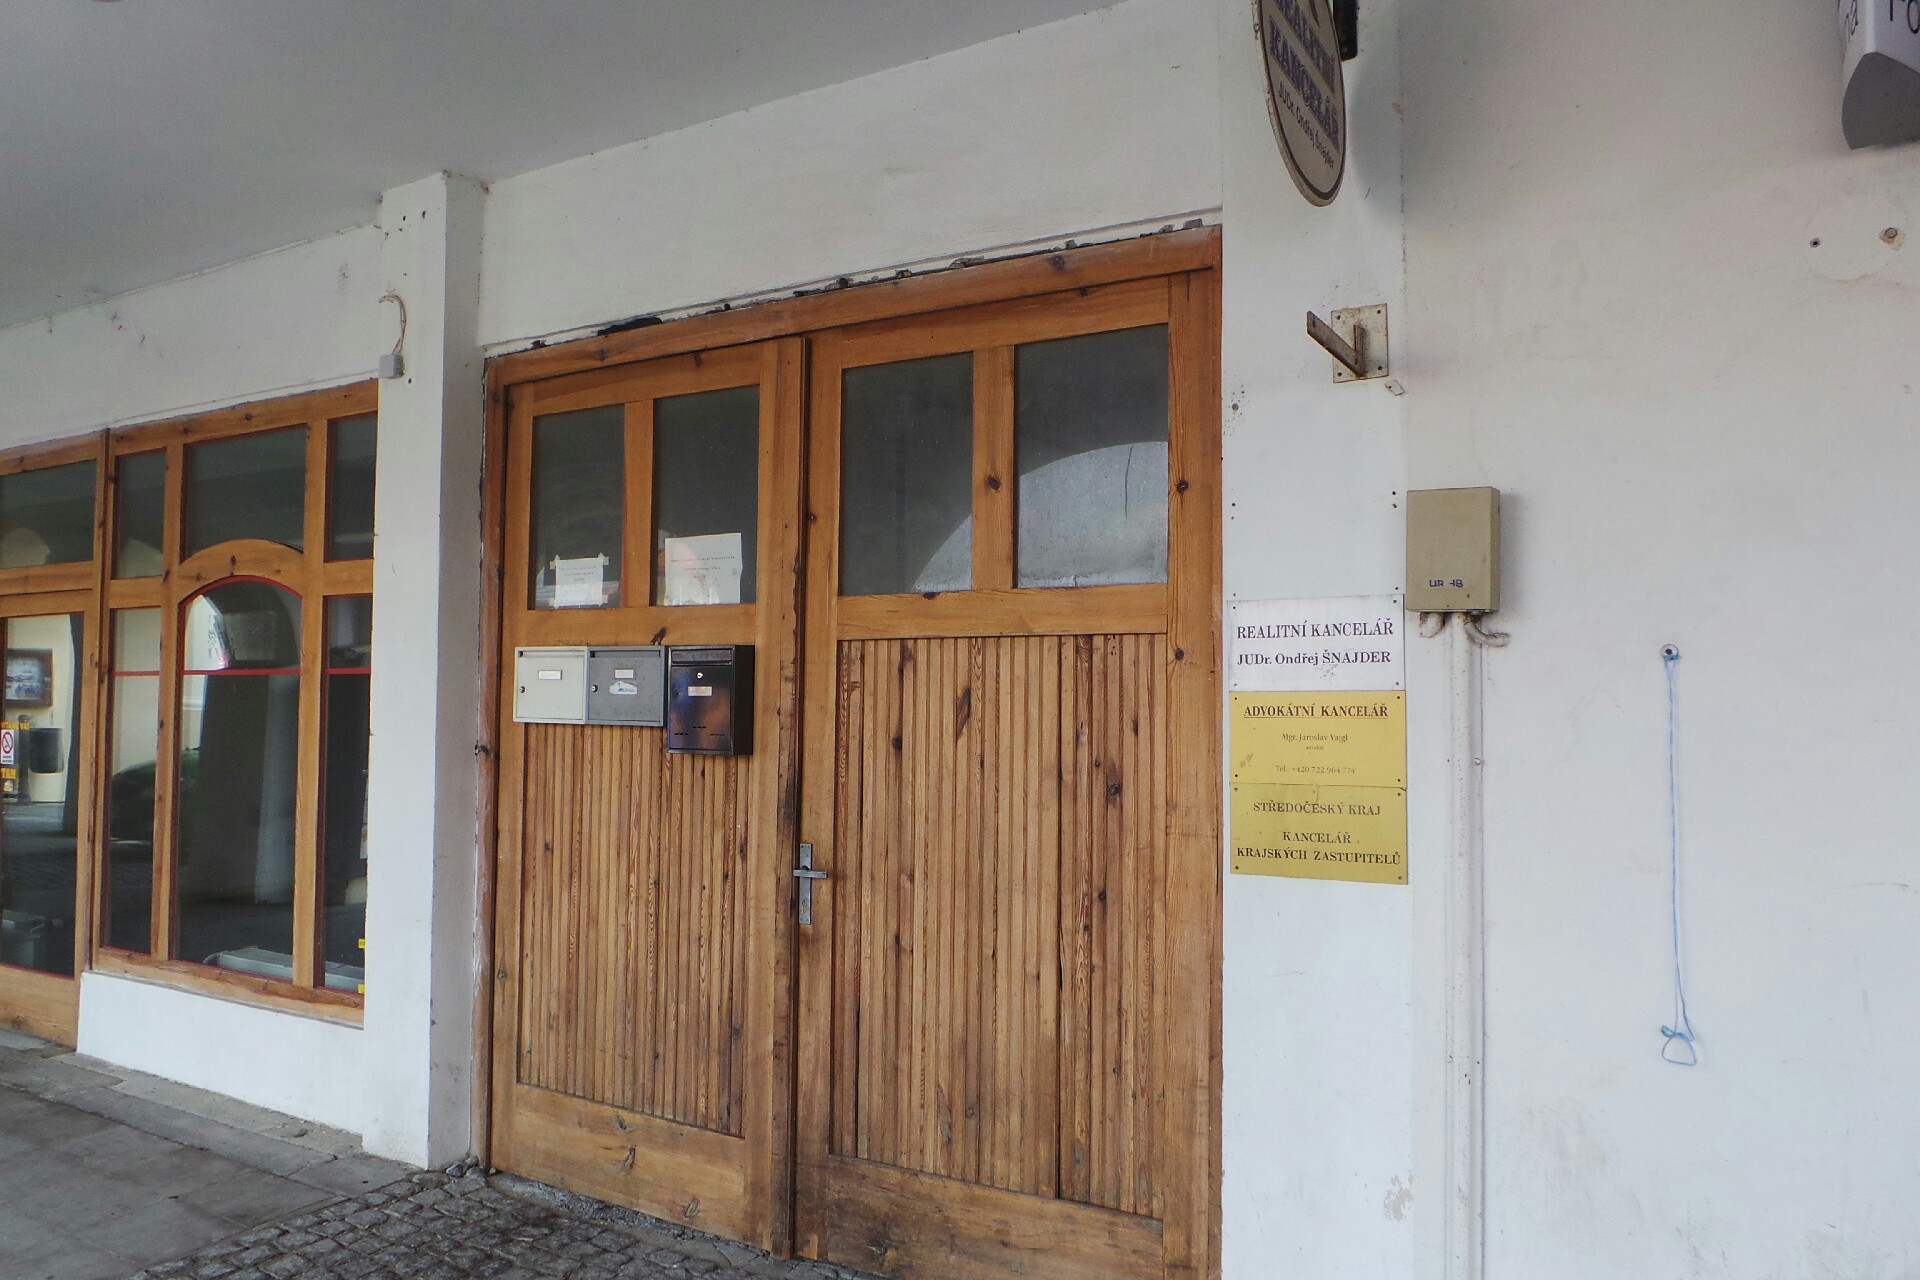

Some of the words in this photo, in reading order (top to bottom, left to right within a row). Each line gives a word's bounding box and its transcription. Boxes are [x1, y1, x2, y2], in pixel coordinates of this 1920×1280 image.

[1269, 15, 1340, 153] KANCELÁŘ
[1237, 620, 1307, 639] REALITNÍ
[1311, 618, 1394, 637] KANCELÁŘ
[1237, 653, 1272, 665] JUDr.
[1275, 652, 1319, 666] Ondřej
[1322, 649, 1391, 664] ŠNAJDER
[1244, 703, 1315, 717] ADVOKÁTNÍ
[1321, 703, 1389, 717] KANCELÁŘ
[1282, 733, 1298, 743] Mgr.
[1299, 733, 1328, 743] Jaroslav
[1311, 766, 1325, 774] 722
[1253, 801, 1345, 815] STŘEDOČESKÝ
[1349, 804, 1381, 816] KRAJ
[1282, 831, 1351, 844] KANCELÁŘ
[1237, 847, 1307, 860] KRAJSKÝCH
[1313, 851, 1401, 865] ZASTUPITELŮ
